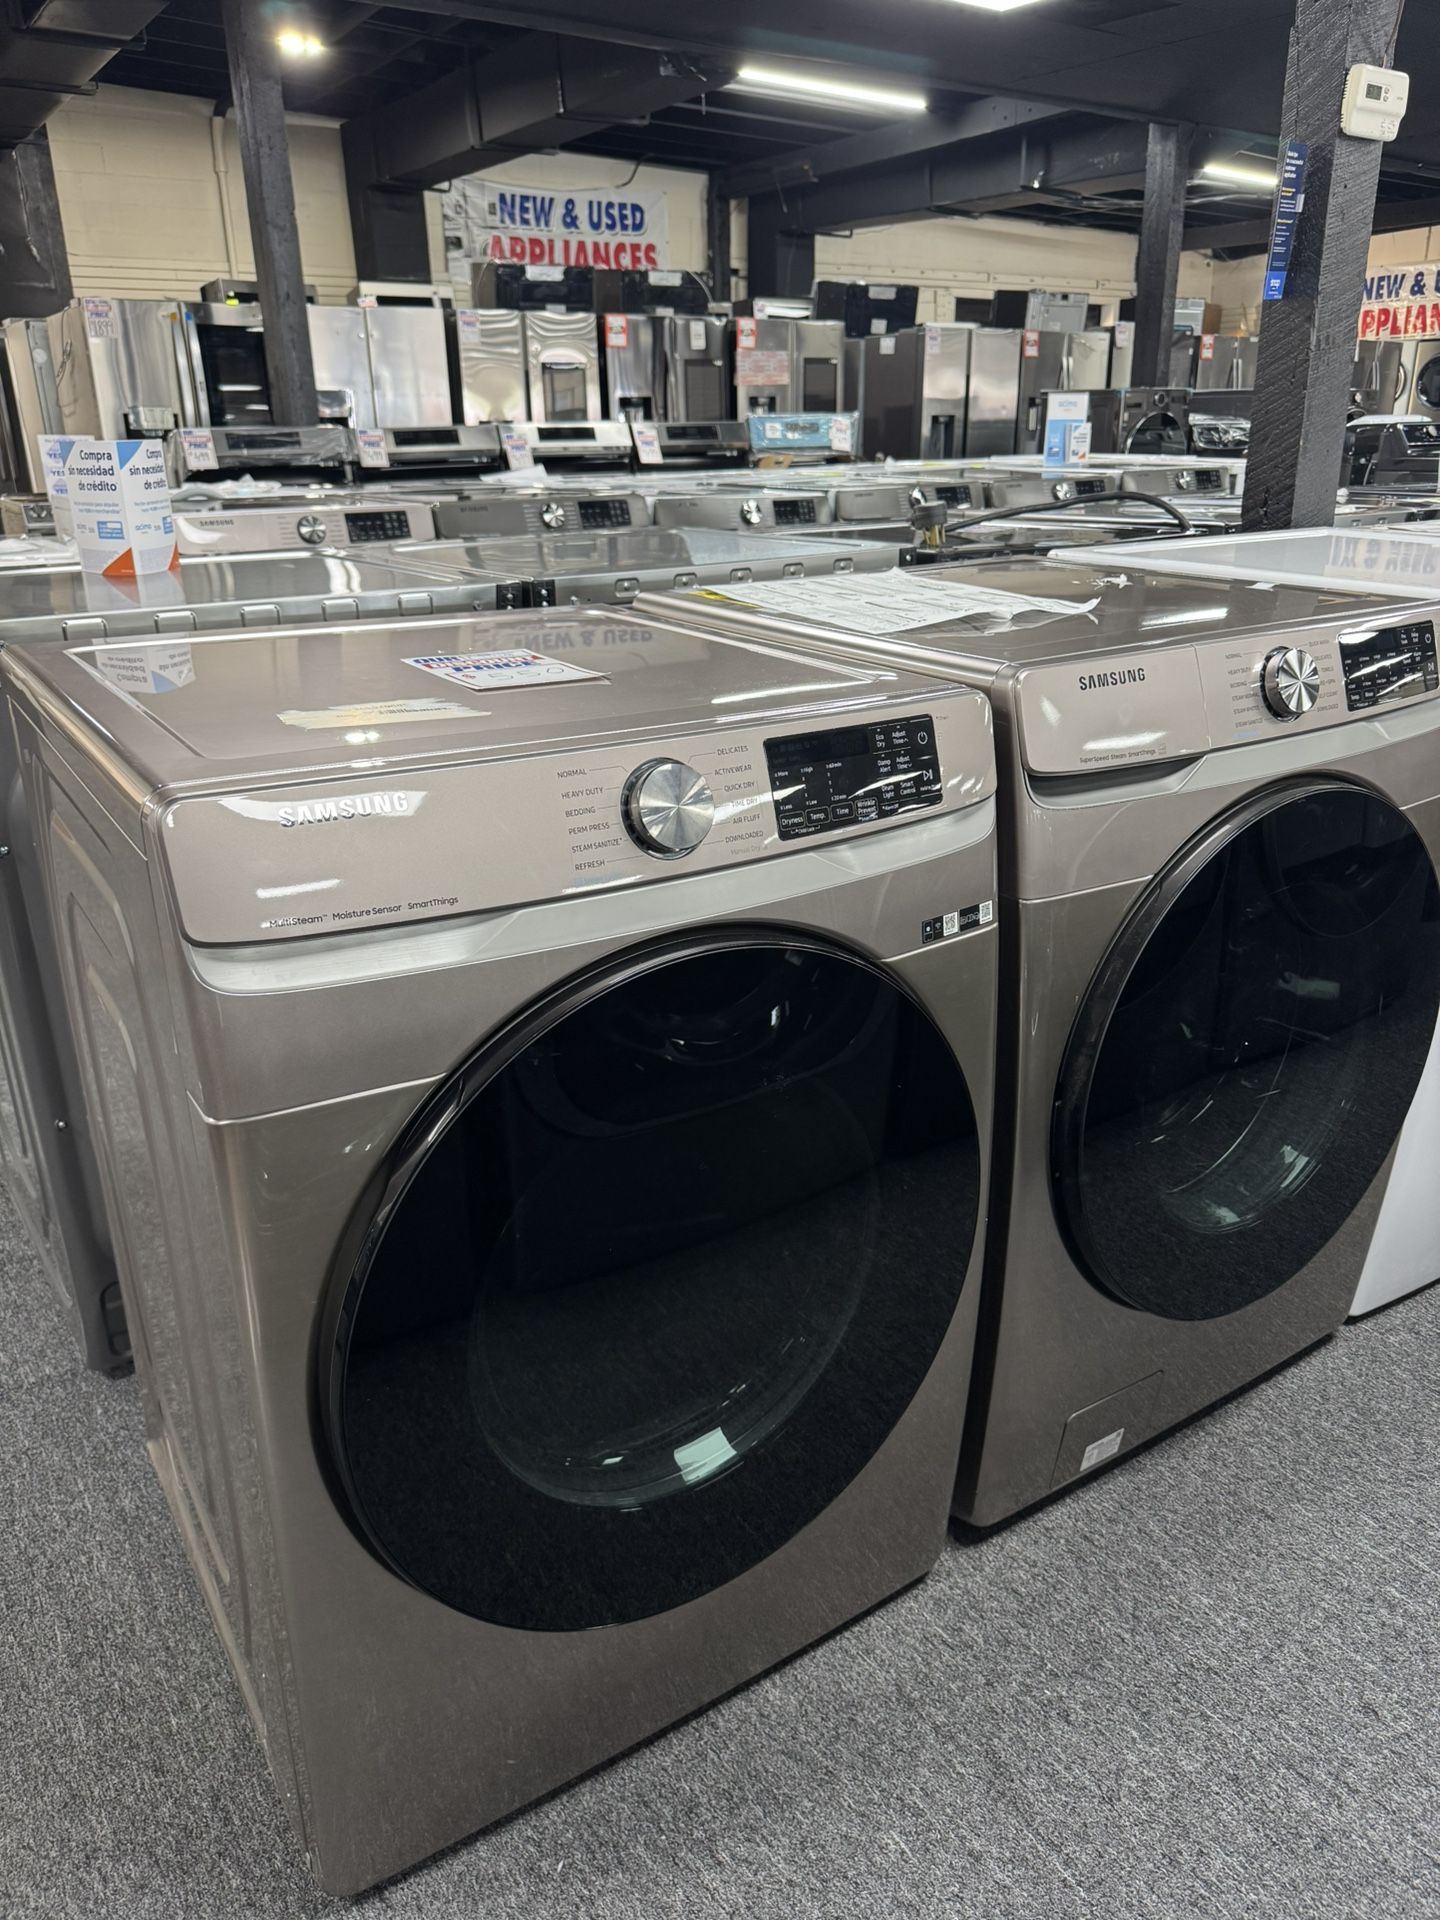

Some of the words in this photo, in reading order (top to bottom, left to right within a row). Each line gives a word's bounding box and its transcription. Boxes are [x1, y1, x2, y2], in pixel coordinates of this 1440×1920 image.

[498, 192, 554, 228] NEW
[562, 198, 580, 231] &
[588, 200, 645, 232] USED
[489, 235, 658, 271] APPLIANCES
[1363, 273, 1406, 301] NEW
[1410, 271, 1426, 297] &
[79, 449, 112, 463] Compra
[76, 465, 115, 476] necesidad
[129, 465, 141, 476] sin
[144, 479, 153, 490] de
[199, 519, 235, 527] SAMSUNG
[413, 656, 460, 664] OUR
[452, 660, 532, 672] PRICE
[1078, 667, 1146, 691] SAMSUNG
[891, 730, 906, 739] Adjust
[716, 745, 749, 756] DELICATES
[896, 755, 911, 764] Adjust
[1110, 752, 1127, 761] Steam
[877, 759, 892, 768] Damp
[557, 768, 587, 780] NORMAL
[714, 764, 752, 776] ACTIVEWEAR
[723, 783, 743, 793] QUICK
[743, 781, 756, 789] DRY
[881, 784, 895, 792] Drum
[900, 780, 915, 788] Smart
[561, 789, 584, 800] HEAVY
[585, 787, 604, 797] DUTY
[882, 791, 895, 800] Light
[899, 787, 916, 796] Control
[731, 800, 746, 809] TIME
[746, 798, 758, 806] DRY
[857, 799, 876, 808] Wrinkle
[278, 792, 409, 828] SAMSUNG
[565, 806, 596, 818] BEDDING
[858, 806, 877, 815] Prevent
[732, 817, 743, 825] AIR
[743, 813, 761, 823] FLUFF
[781, 816, 804, 827] Dryness
[810, 812, 826, 820] Temp.
[568, 825, 588, 836] PERM
[589, 822, 611, 832] PRESS
[725, 831, 764, 844] DOWNLOADED
[571, 843, 594, 854] STEAM
[574, 860, 606, 871] REFRESH
[332, 908, 371, 921] Moisture
[372, 904, 402, 915] Sensor
[407, 896, 459, 911] SmartThings
